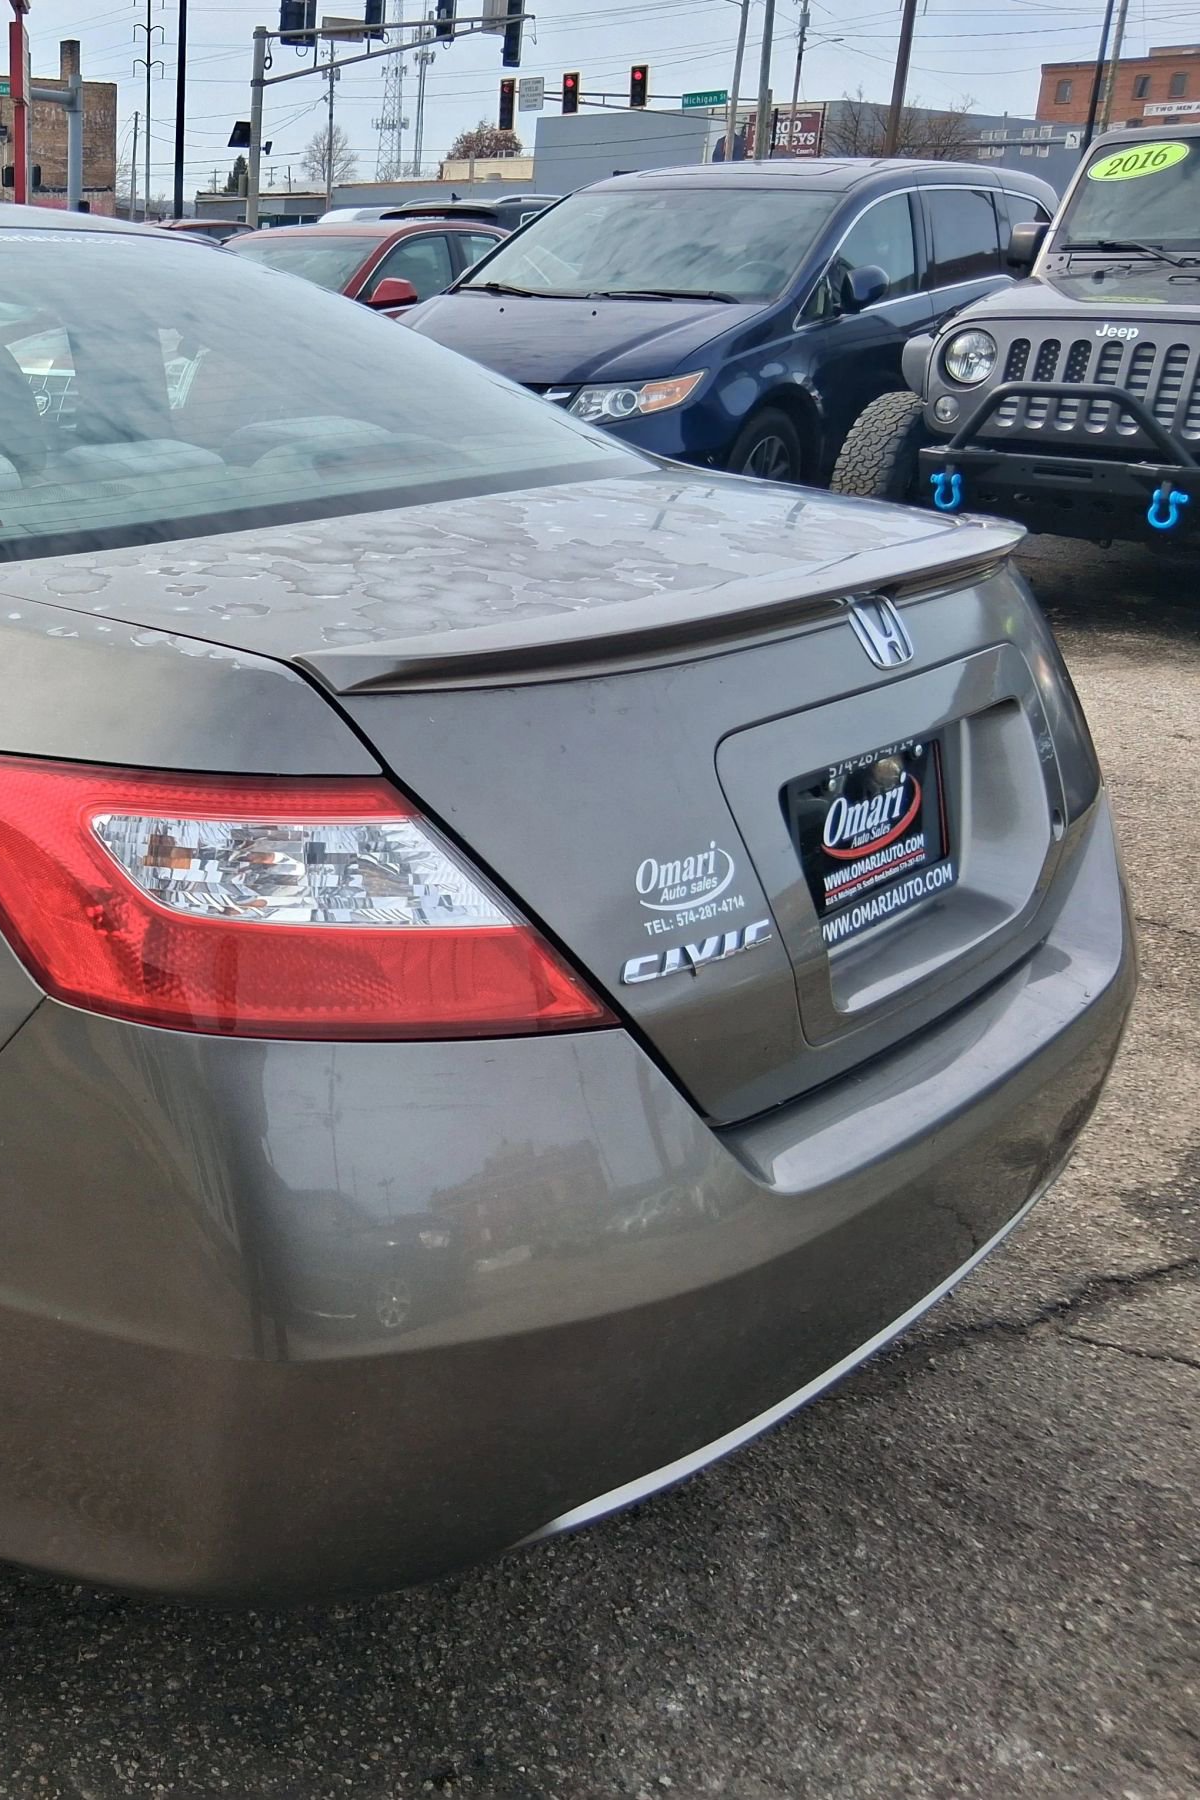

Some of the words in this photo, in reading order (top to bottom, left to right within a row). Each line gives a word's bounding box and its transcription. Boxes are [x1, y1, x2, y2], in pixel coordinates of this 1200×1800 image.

[684, 95, 718, 105] Michigan
[1104, 145, 1173, 177] 2016
[1095, 323, 1139, 341] Jeep
[823, 771, 907, 847] Omari
[851, 833, 870, 849] Auto
[870, 822, 891, 839] Sales
[636, 841, 716, 894] Omari
[823, 833, 925, 892] WWW.OMARIAUTO.COM
[660, 885, 687, 903] Auto
[690, 877, 718, 894] sales
[644, 918, 675, 936] TEL:
[676, 895, 745, 927] 574-287-4714
[623, 919, 772, 984] CIVIC
